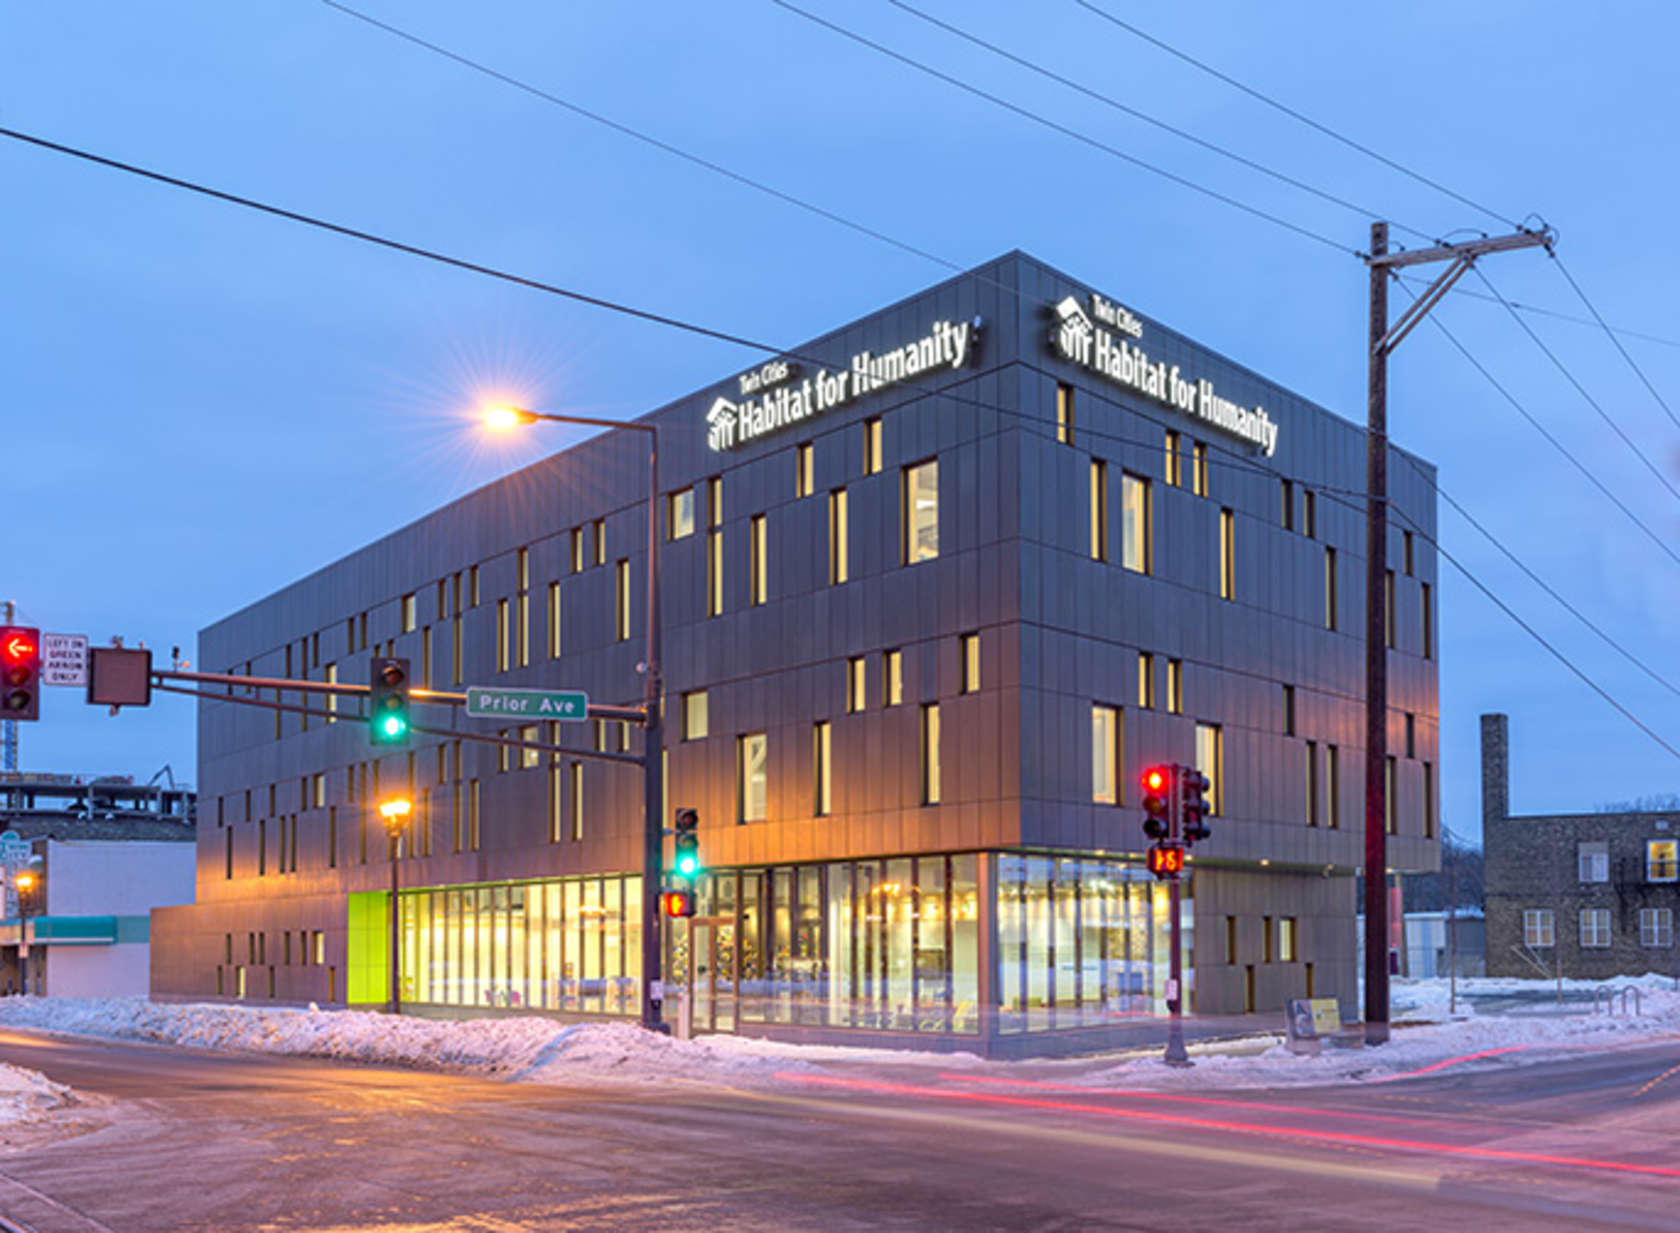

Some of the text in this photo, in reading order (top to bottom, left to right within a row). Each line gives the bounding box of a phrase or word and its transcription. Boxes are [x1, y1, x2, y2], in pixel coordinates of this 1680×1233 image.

[1093, 294, 1143, 339] Twin Cities
[738, 320, 969, 442] Habitat for Humanity
[739, 361, 789, 395] Twin Cities
[1095, 328, 1279, 458] Habitat for Humanity
[47, 639, 69, 649] LEFT
[49, 651, 82, 659] GREEN
[48, 662, 83, 670] ARROW
[52, 672, 78, 681] ONLY
[480, 694, 575, 714] Prior Ave
